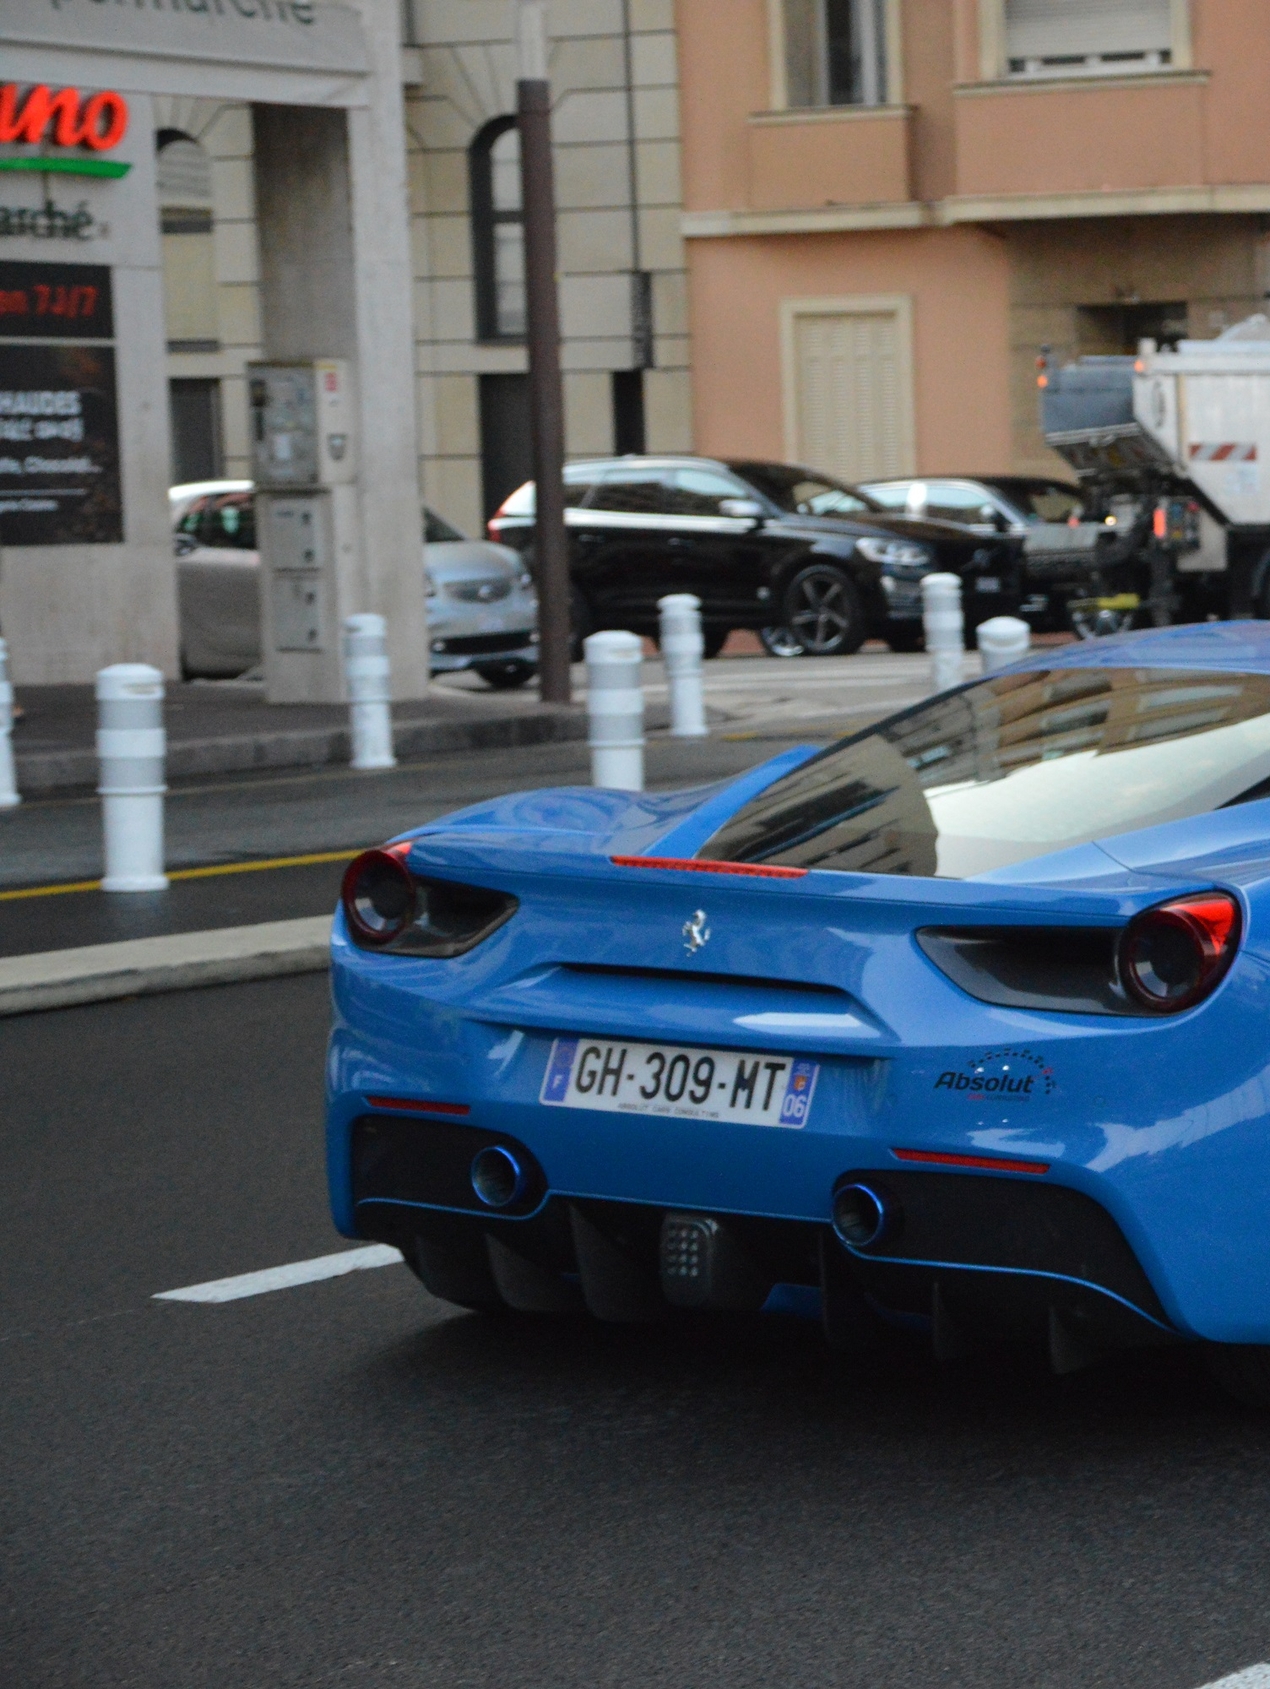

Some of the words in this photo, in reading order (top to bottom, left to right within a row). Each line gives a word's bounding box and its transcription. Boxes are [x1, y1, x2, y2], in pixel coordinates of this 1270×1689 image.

[552, 1075, 563, 1089] F
[575, 1046, 786, 1111] GH-309-MT
[933, 1071, 1034, 1093] Absolut
[784, 1094, 806, 1118] 06
